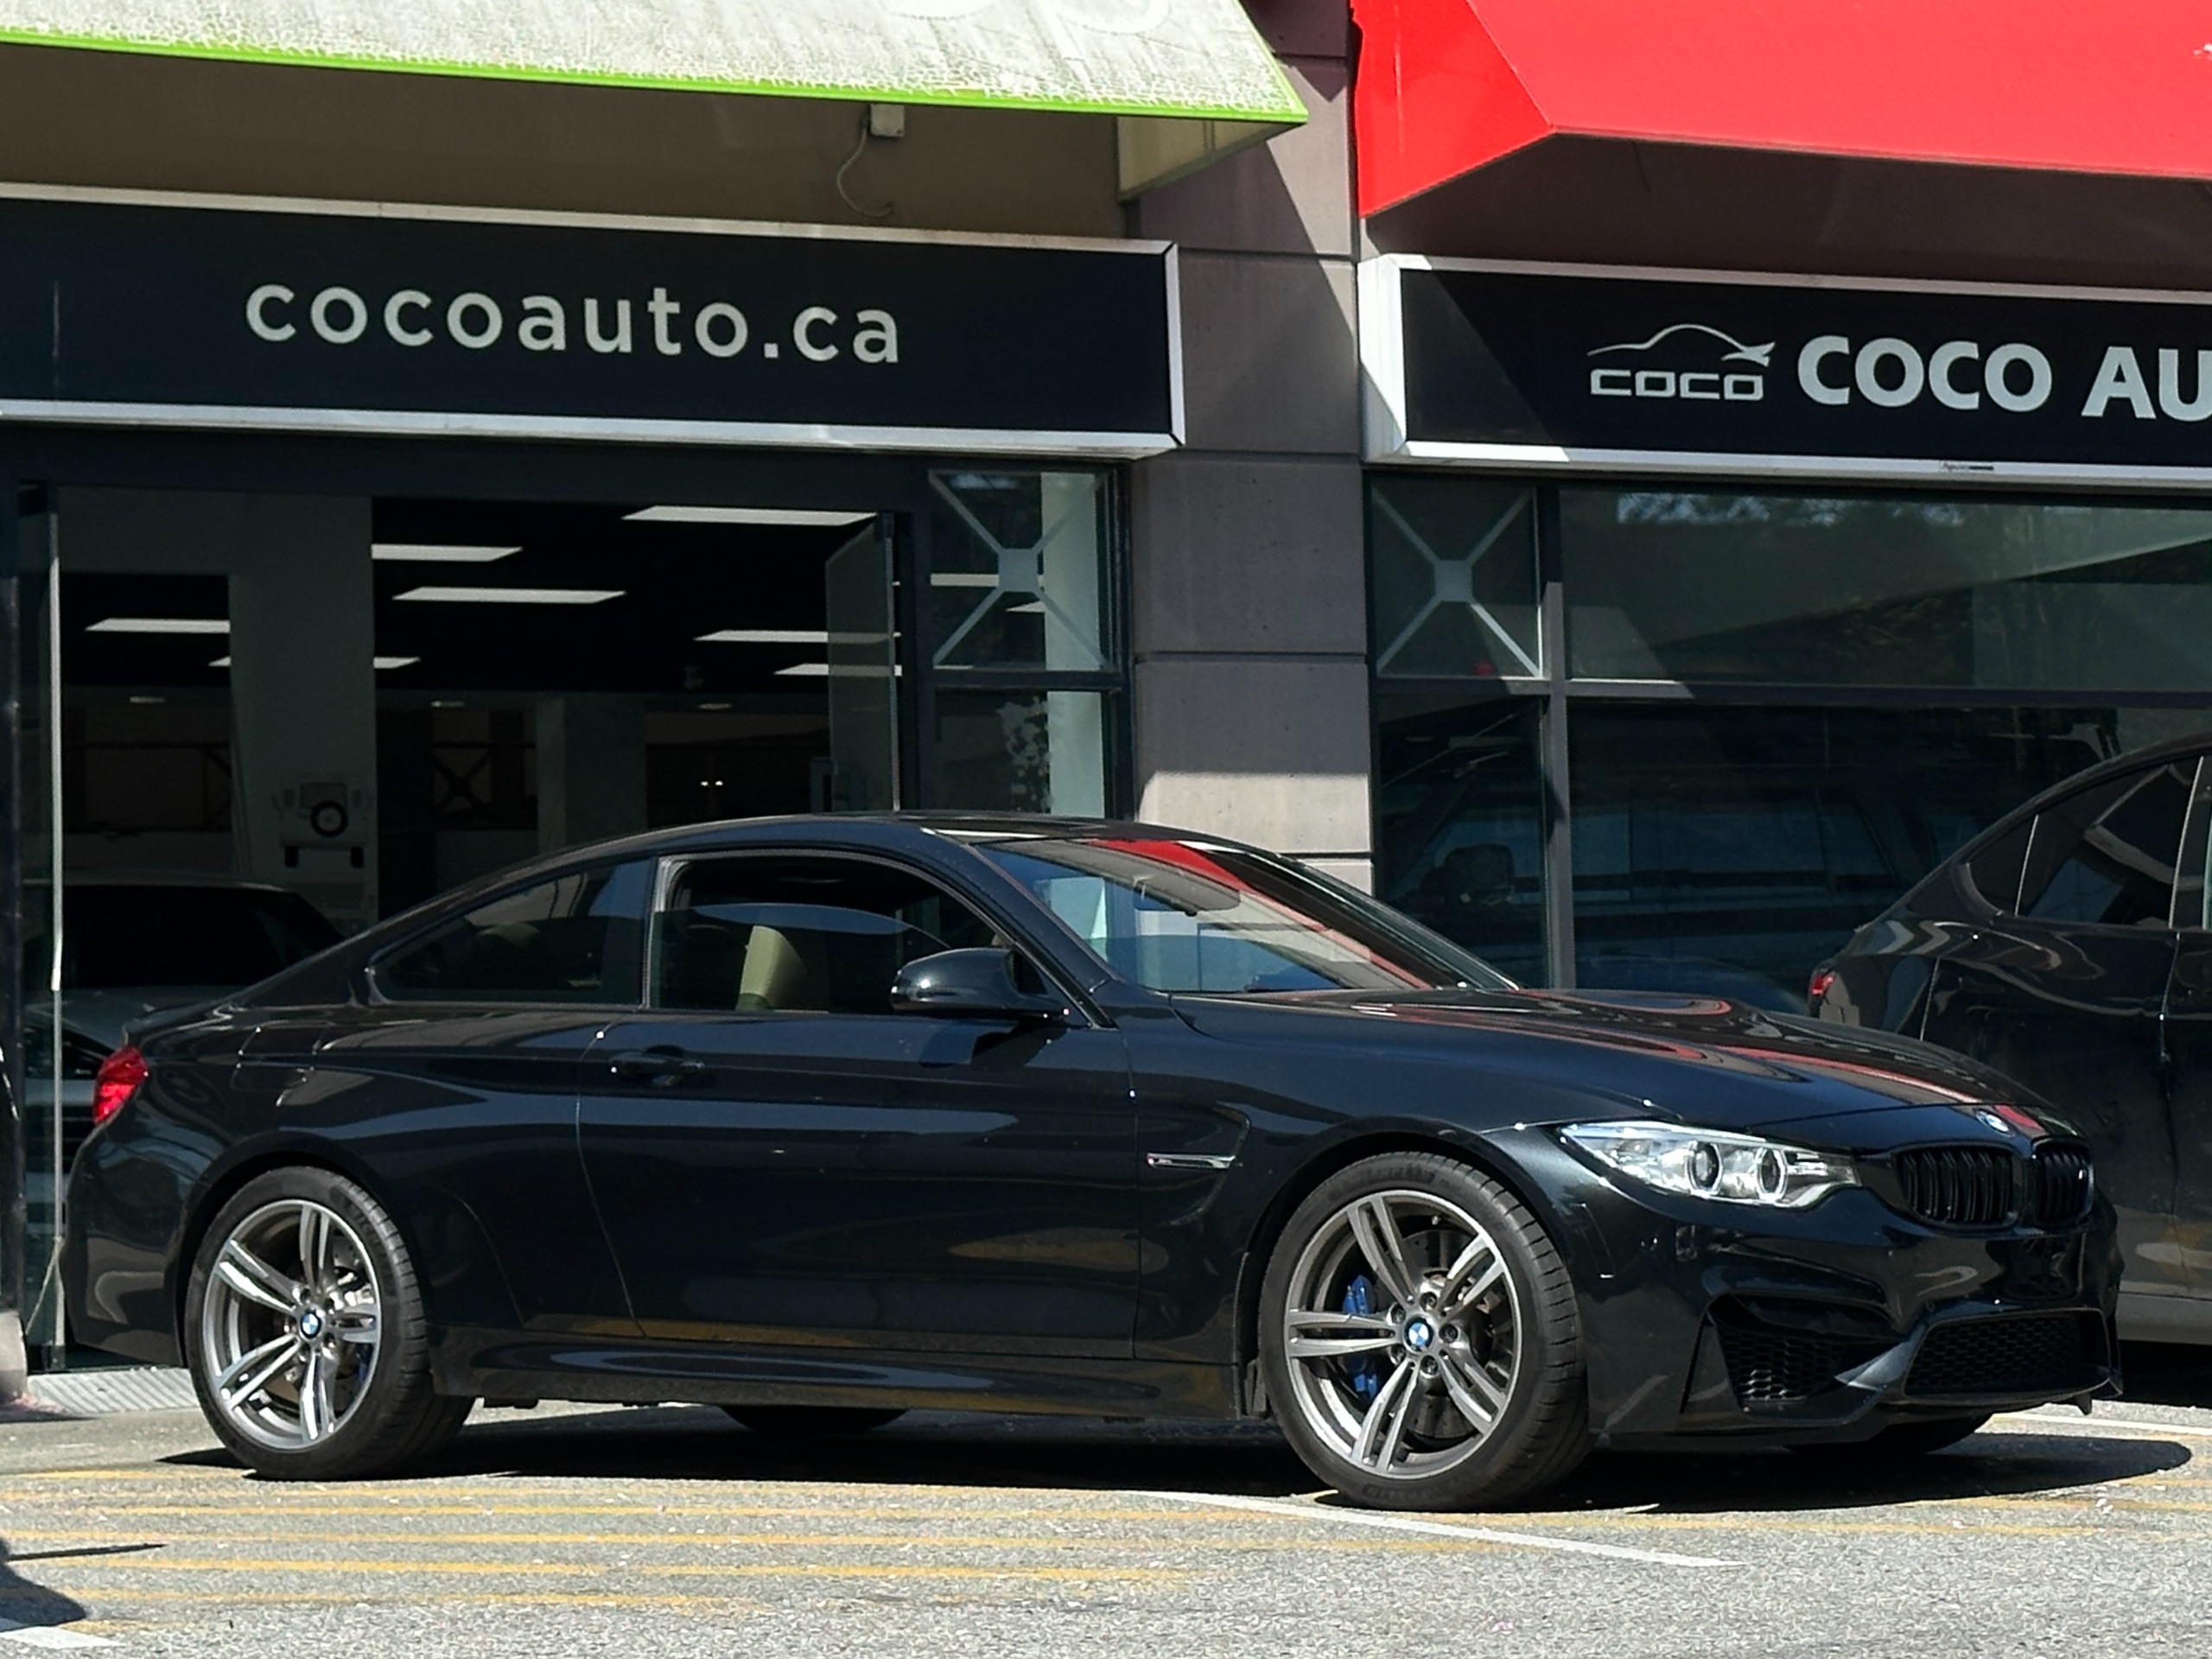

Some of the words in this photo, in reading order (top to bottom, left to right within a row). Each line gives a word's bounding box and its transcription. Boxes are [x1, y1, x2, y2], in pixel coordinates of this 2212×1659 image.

[246, 284, 899, 362] cocoauto.ca
[1797, 335, 2052, 412] COCO
[2081, 346, 2212, 422] AU
